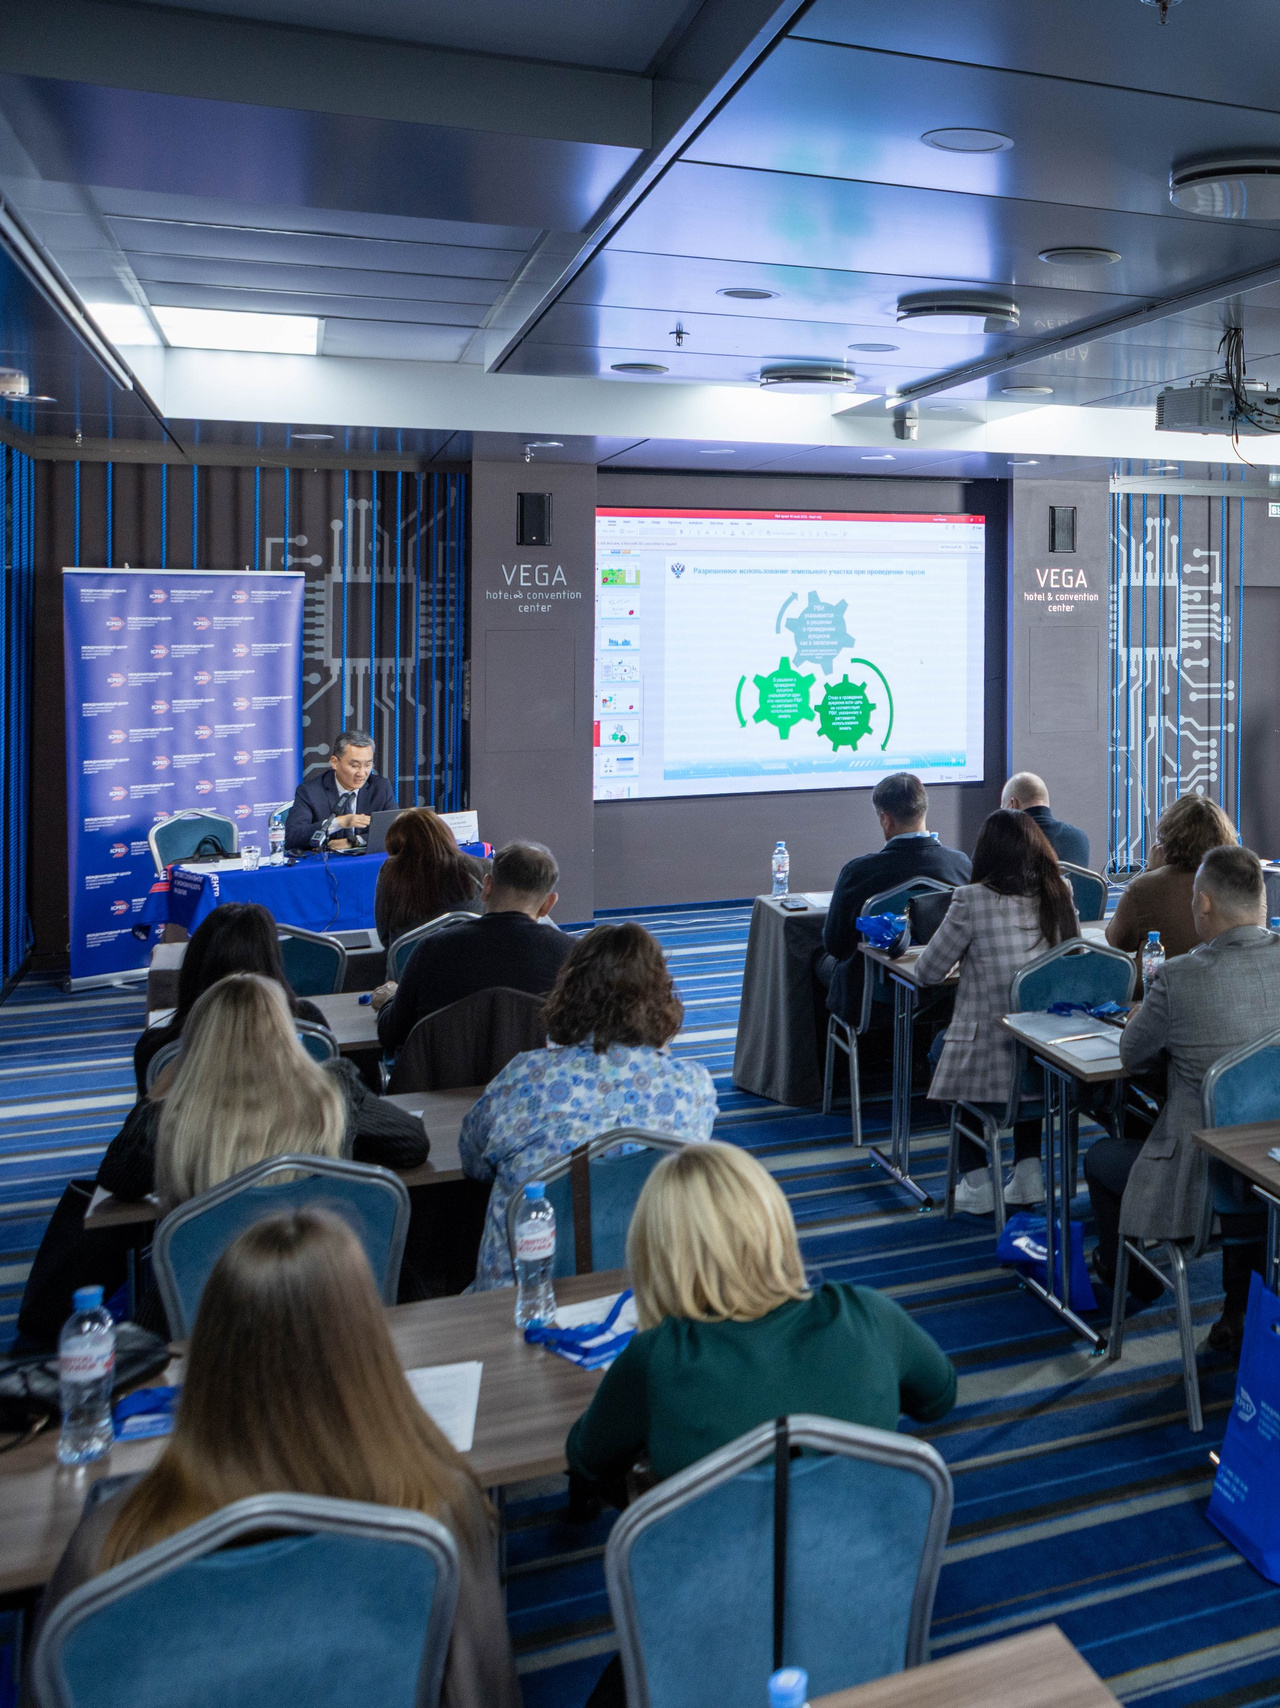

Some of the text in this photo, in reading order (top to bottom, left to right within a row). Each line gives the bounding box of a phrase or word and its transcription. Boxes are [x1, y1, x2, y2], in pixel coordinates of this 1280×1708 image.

[502, 564, 567, 586] VEGA
[693, 567, 737, 575] Разрешенное
[1036, 569, 1087, 588] VEGA
[527, 590, 582, 600] convention
[1024, 592, 1099, 601] hotel & convention
[518, 603, 552, 612] center
[1048, 604, 1074, 612] center
